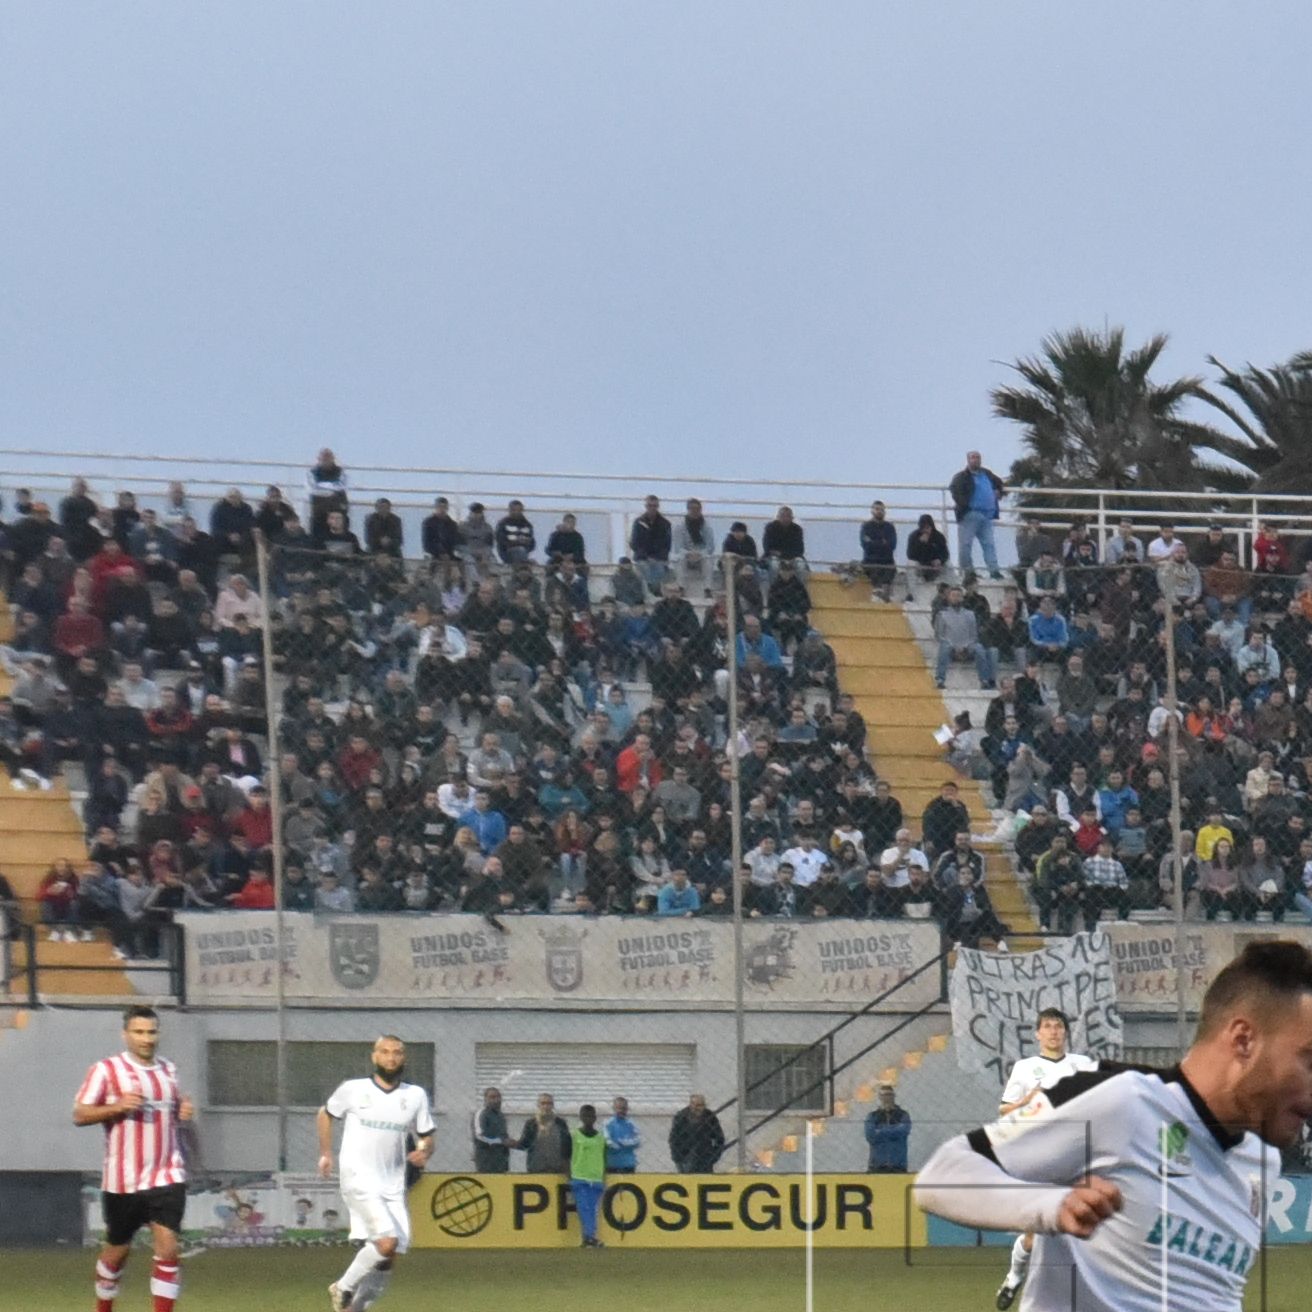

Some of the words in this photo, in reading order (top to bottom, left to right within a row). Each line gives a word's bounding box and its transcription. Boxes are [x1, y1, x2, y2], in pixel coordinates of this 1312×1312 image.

[410, 932, 487, 953] UNIDOS
[617, 931, 693, 956] UNIDOS
[817, 934, 891, 958] UNIDOS
[412, 952, 468, 969] FUTBOL
[620, 952, 676, 972] FUTBOL
[821, 955, 873, 973] FUTBOL
[960, 945, 1066, 983] ULTRAS
